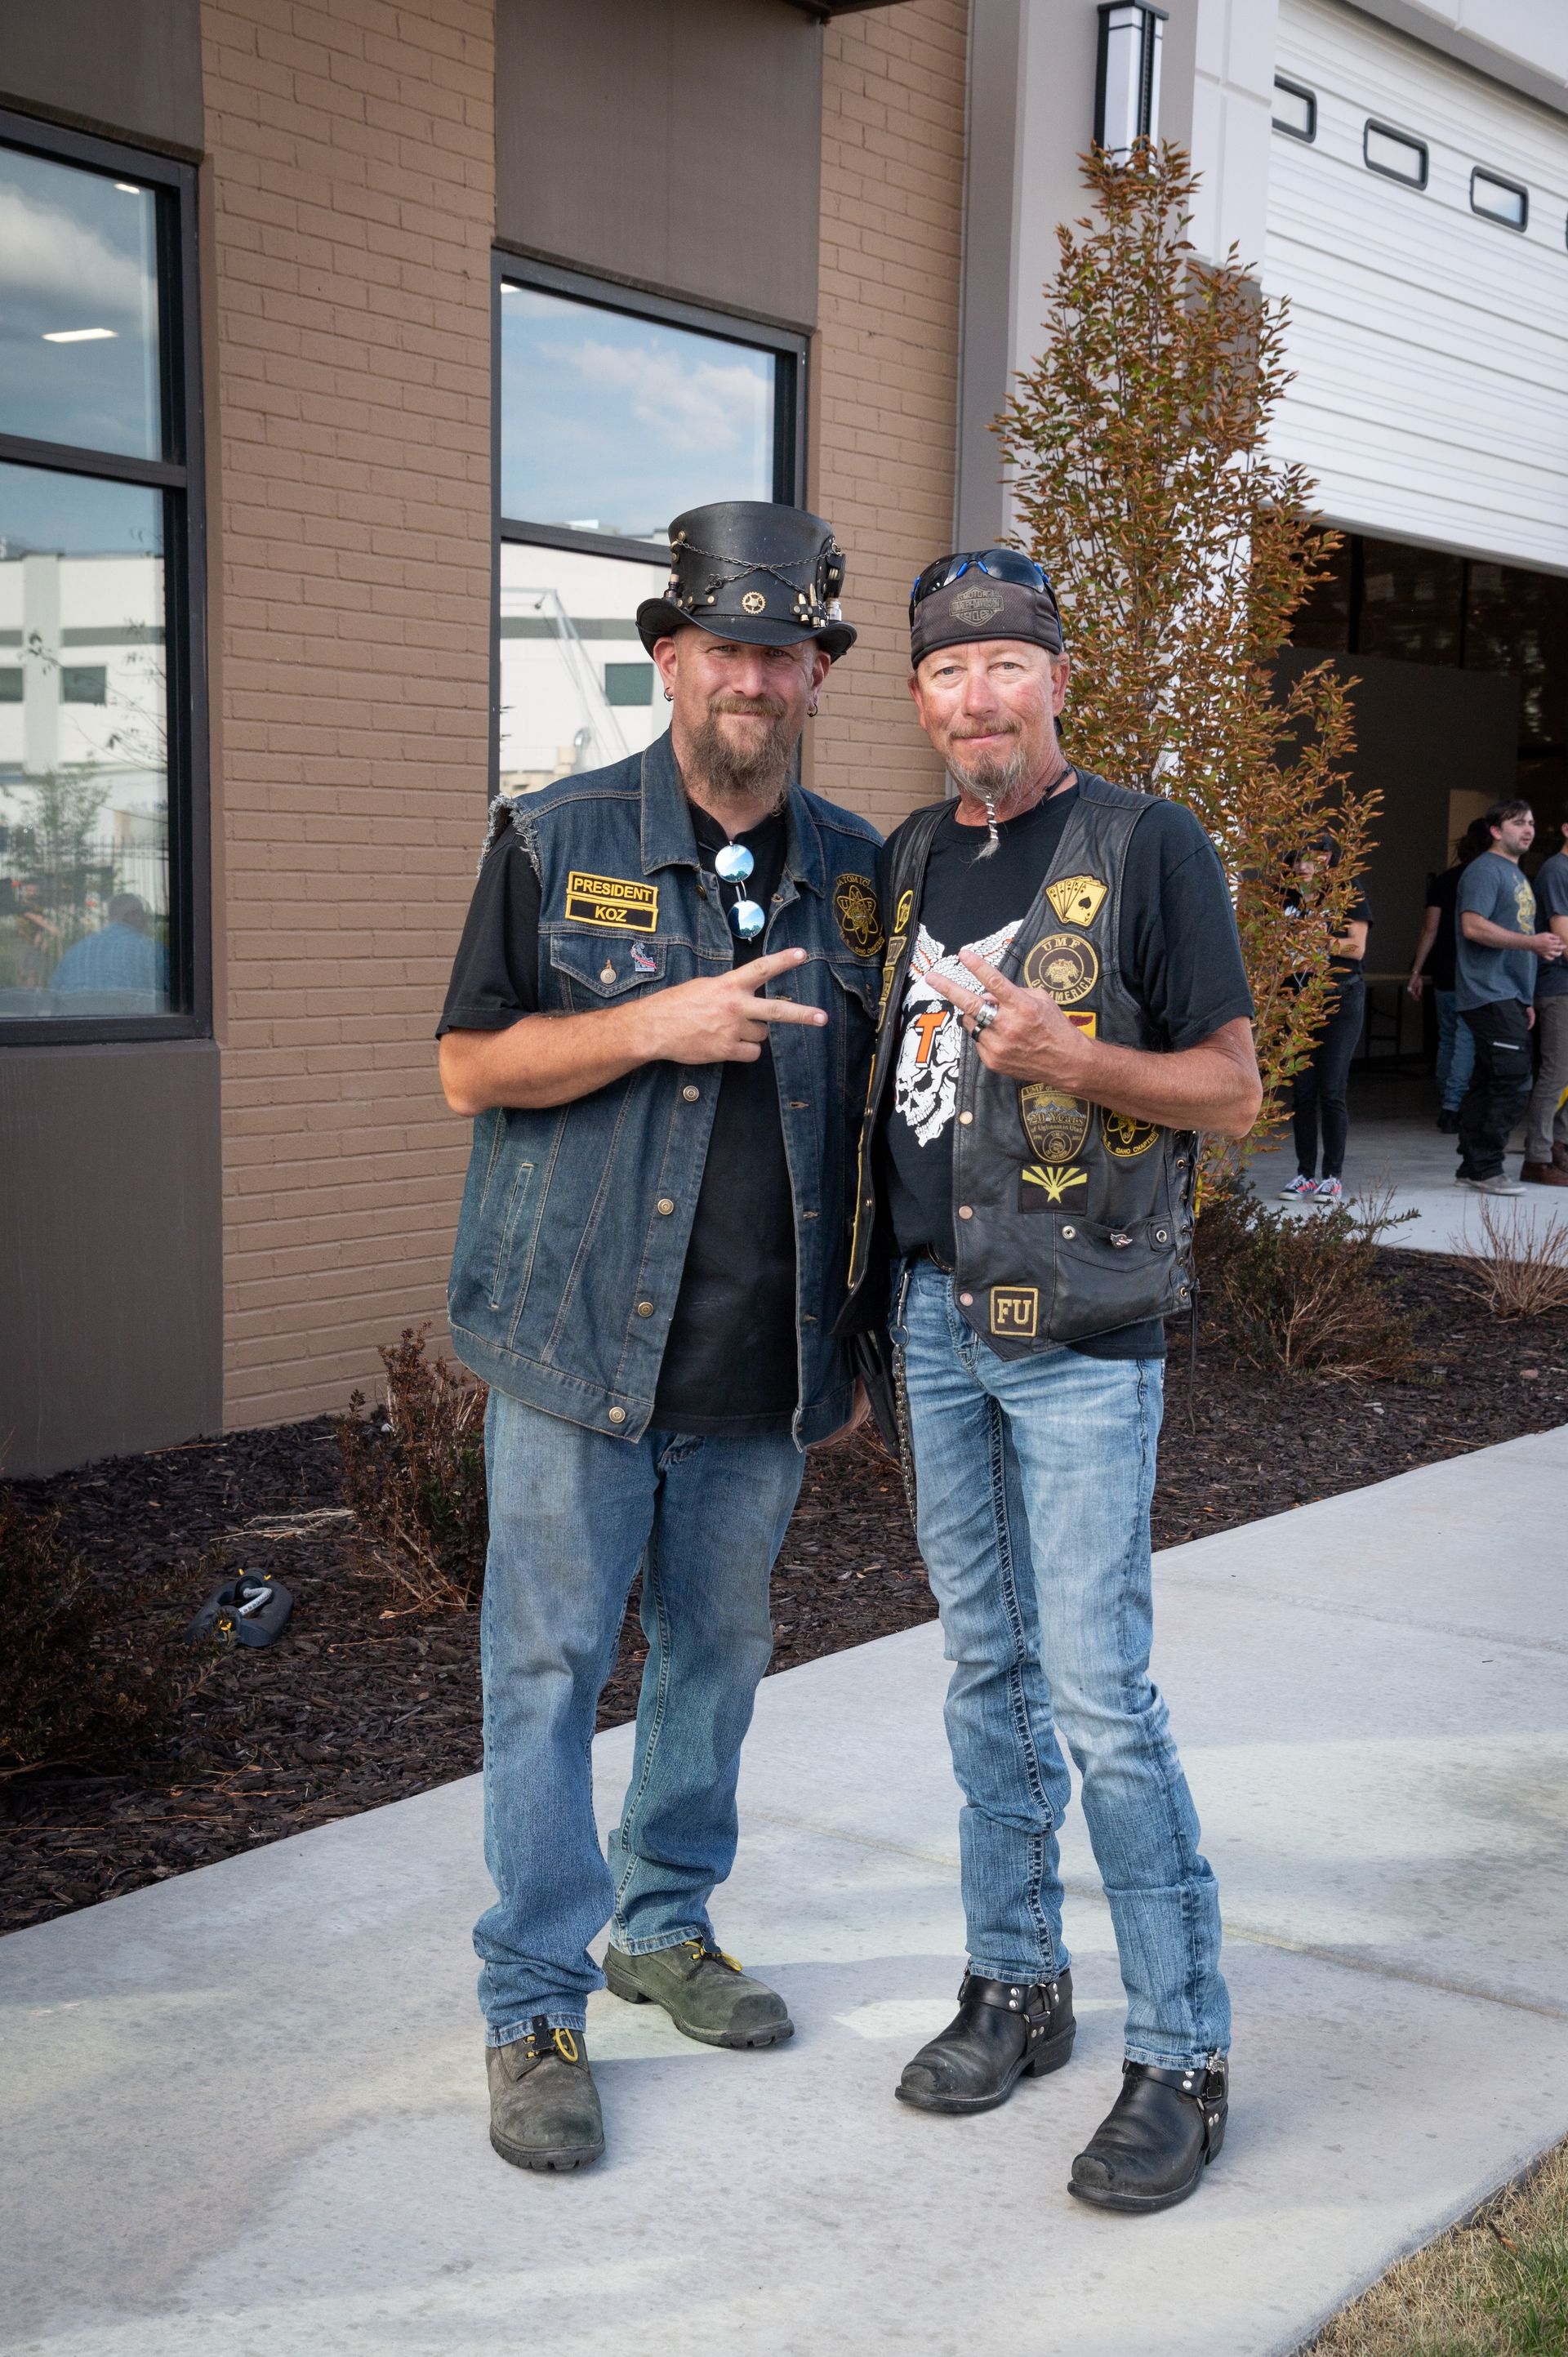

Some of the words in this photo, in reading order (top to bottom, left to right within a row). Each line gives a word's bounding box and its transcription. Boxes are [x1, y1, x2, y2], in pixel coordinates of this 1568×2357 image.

[838, 875, 869, 887] ATOMIC
[573, 877, 652, 902] PRESIDENT
[595, 906, 628, 922] KOZ
[1041, 938, 1080, 951] UMF
[1049, 976, 1093, 1001] AMERICA
[915, 1010, 951, 1070] T
[1026, 1085, 1045, 1095] UMF
[1030, 1112, 1046, 1124] 20
[1069, 1125, 1084, 1134] Utah
[1133, 1131, 1156, 1153] CHAPTER
[996, 1298, 1032, 1326] FU
